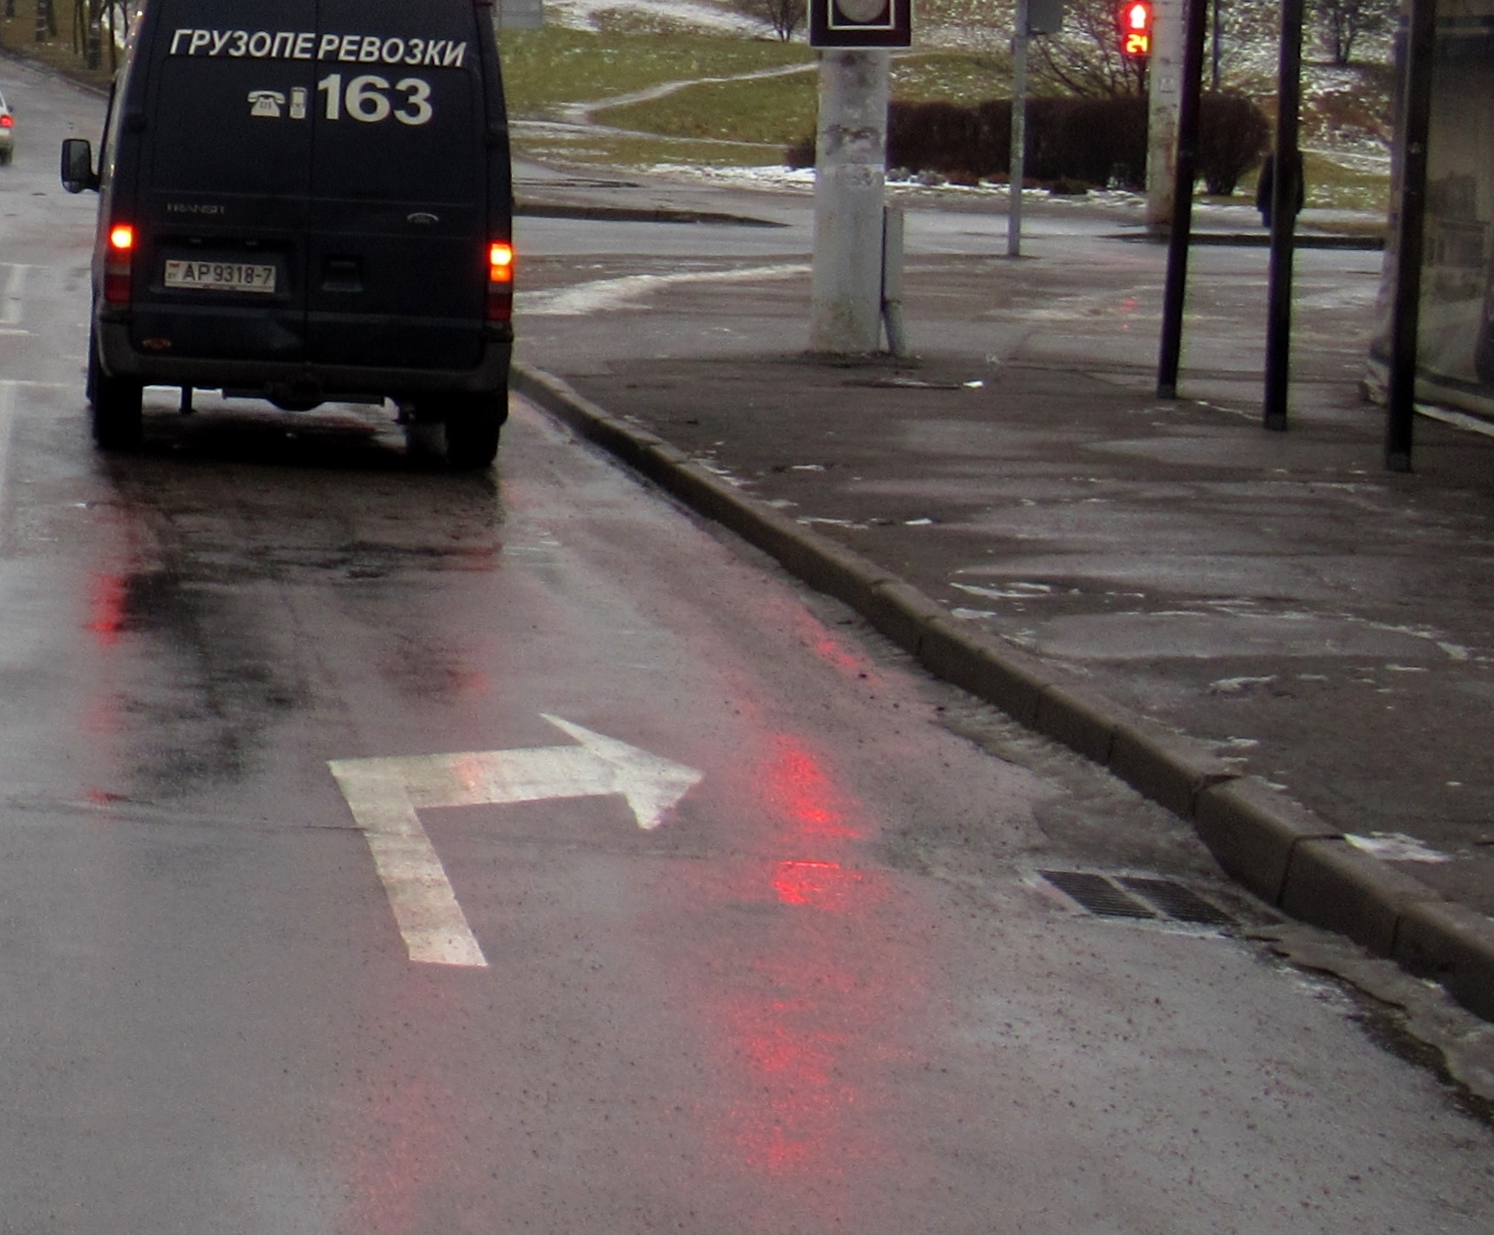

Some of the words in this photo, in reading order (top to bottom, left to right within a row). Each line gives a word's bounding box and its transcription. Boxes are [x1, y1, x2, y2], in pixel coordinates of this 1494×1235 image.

[169, 28, 467, 68] ГРУЗОПЕРЕВОЗКИ
[317, 72, 433, 126] 163
[182, 263, 210, 281] AP
[213, 265, 273, 285] 9318-7
